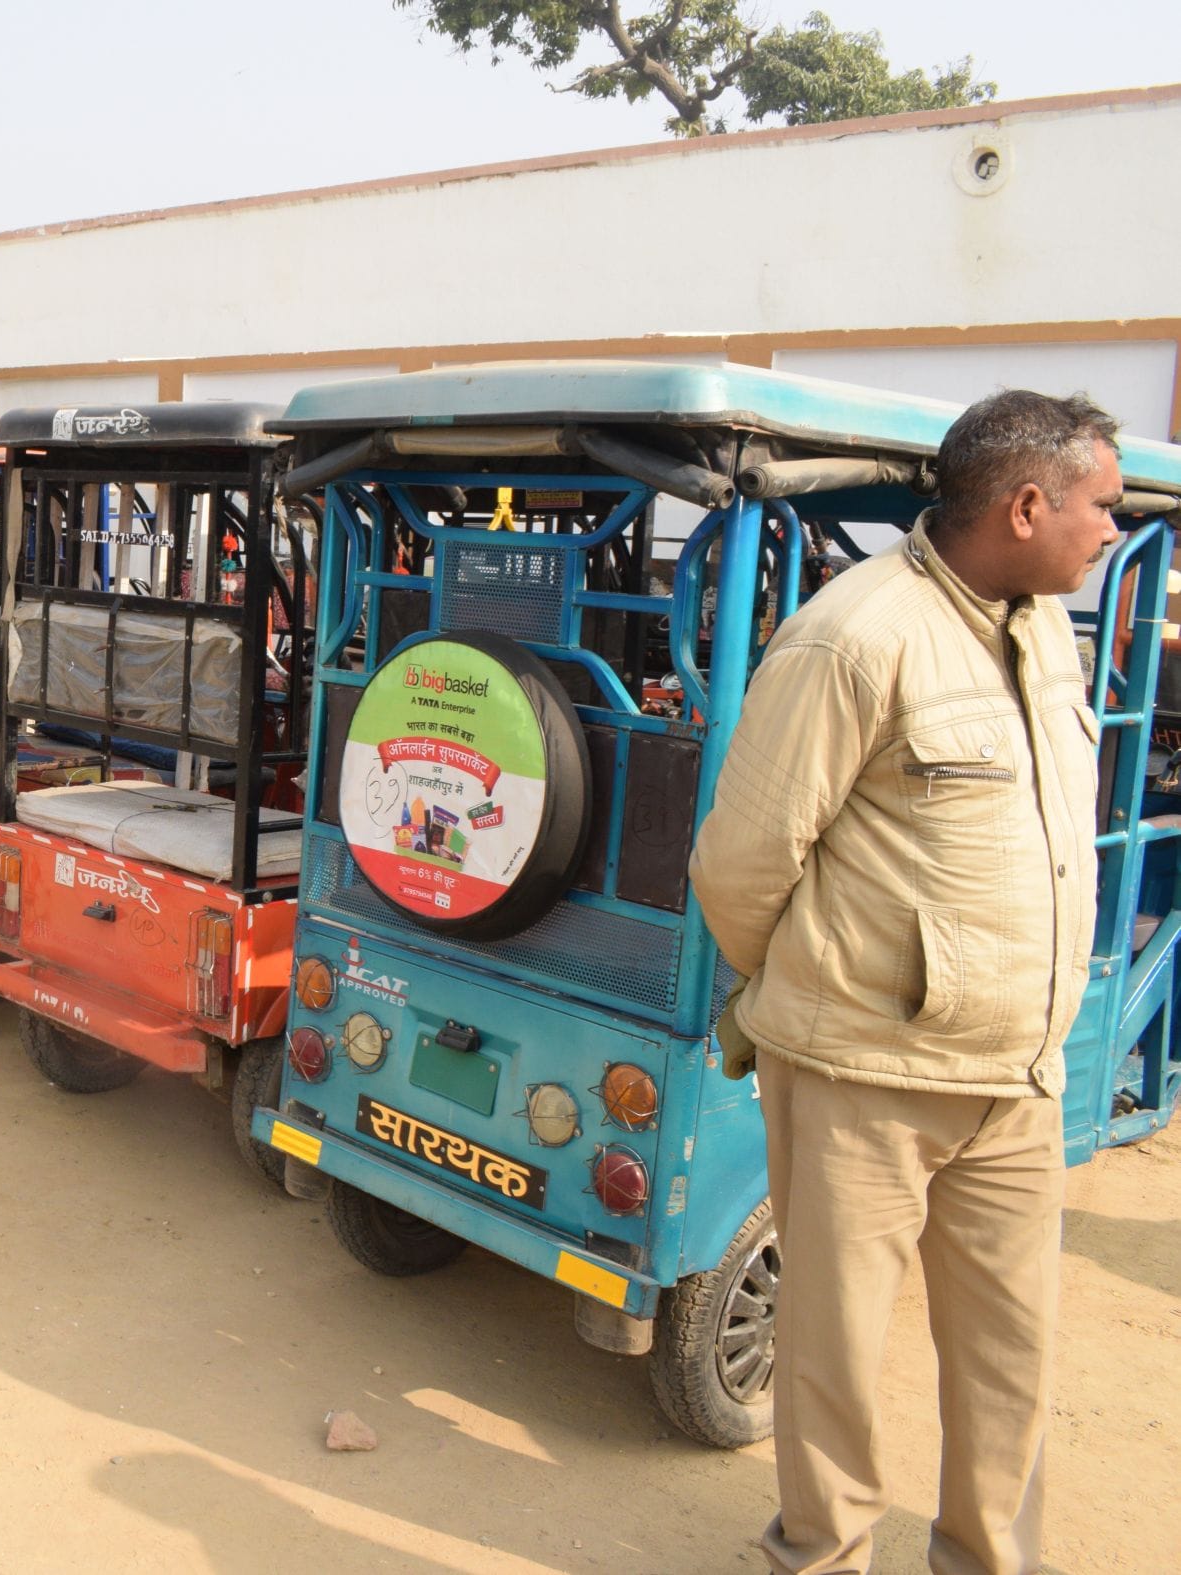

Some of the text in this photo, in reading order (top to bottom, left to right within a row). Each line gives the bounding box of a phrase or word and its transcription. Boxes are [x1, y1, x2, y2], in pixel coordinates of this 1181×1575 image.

[422, 668, 489, 698] bigbasket
[411, 697, 476, 715] A TATA Enterprise
[406, 721, 475, 743] भारत का सबसे बड़ा
[455, 781, 464, 795] में
[475, 813, 498, 828] सस्ता
[418, 868, 432, 880] 6%
[433, 870, 443, 883] की
[338, 977, 406, 1007] APPROVED
